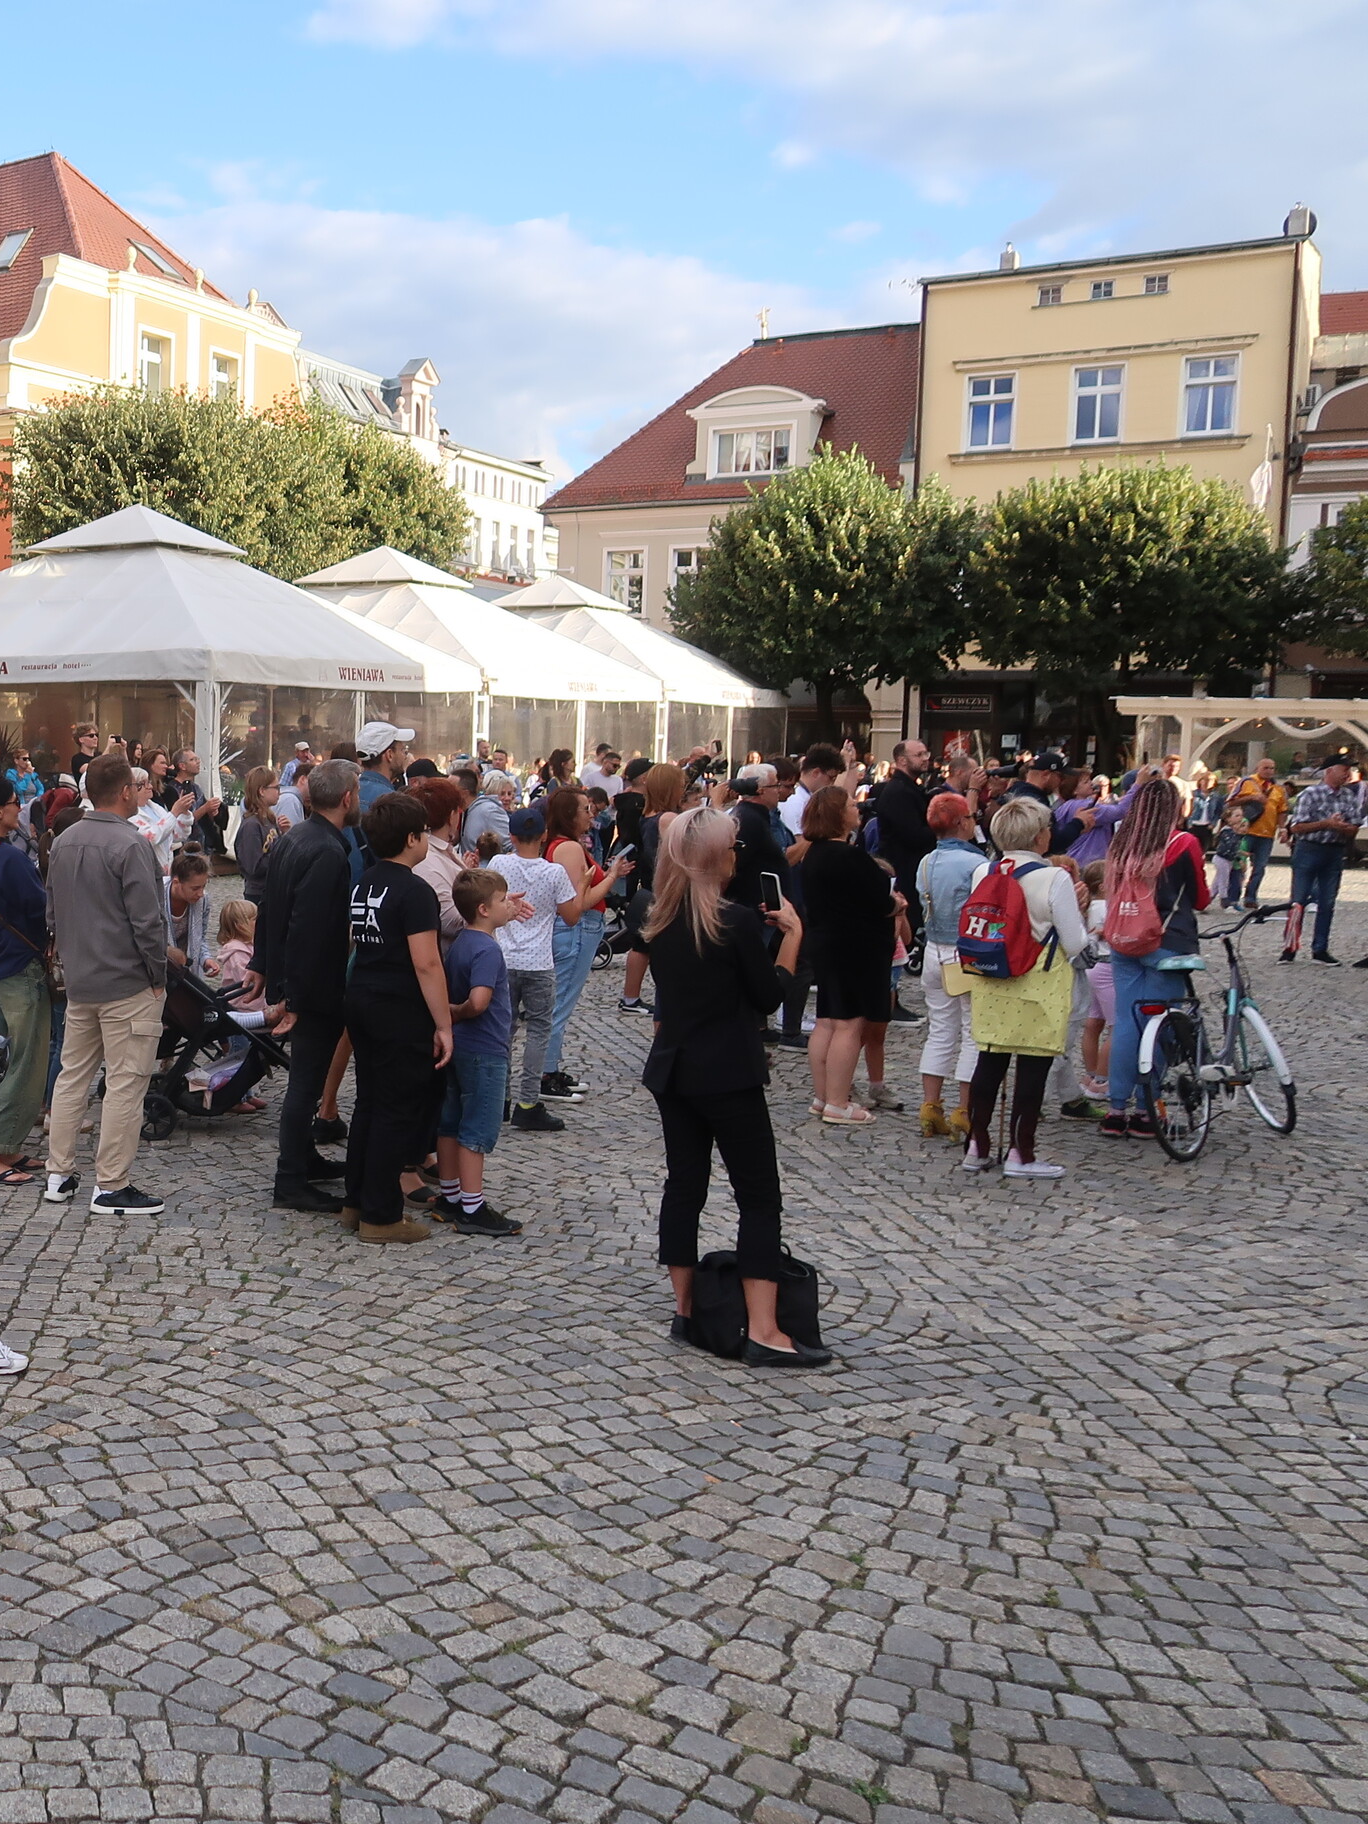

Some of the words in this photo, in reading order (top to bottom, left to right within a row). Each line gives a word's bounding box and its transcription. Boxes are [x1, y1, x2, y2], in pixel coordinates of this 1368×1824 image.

[21, 663, 58, 671] restauracja
[338, 667, 385, 682] WIENIAWA
[941, 697, 989, 705] SZEWCZYK
